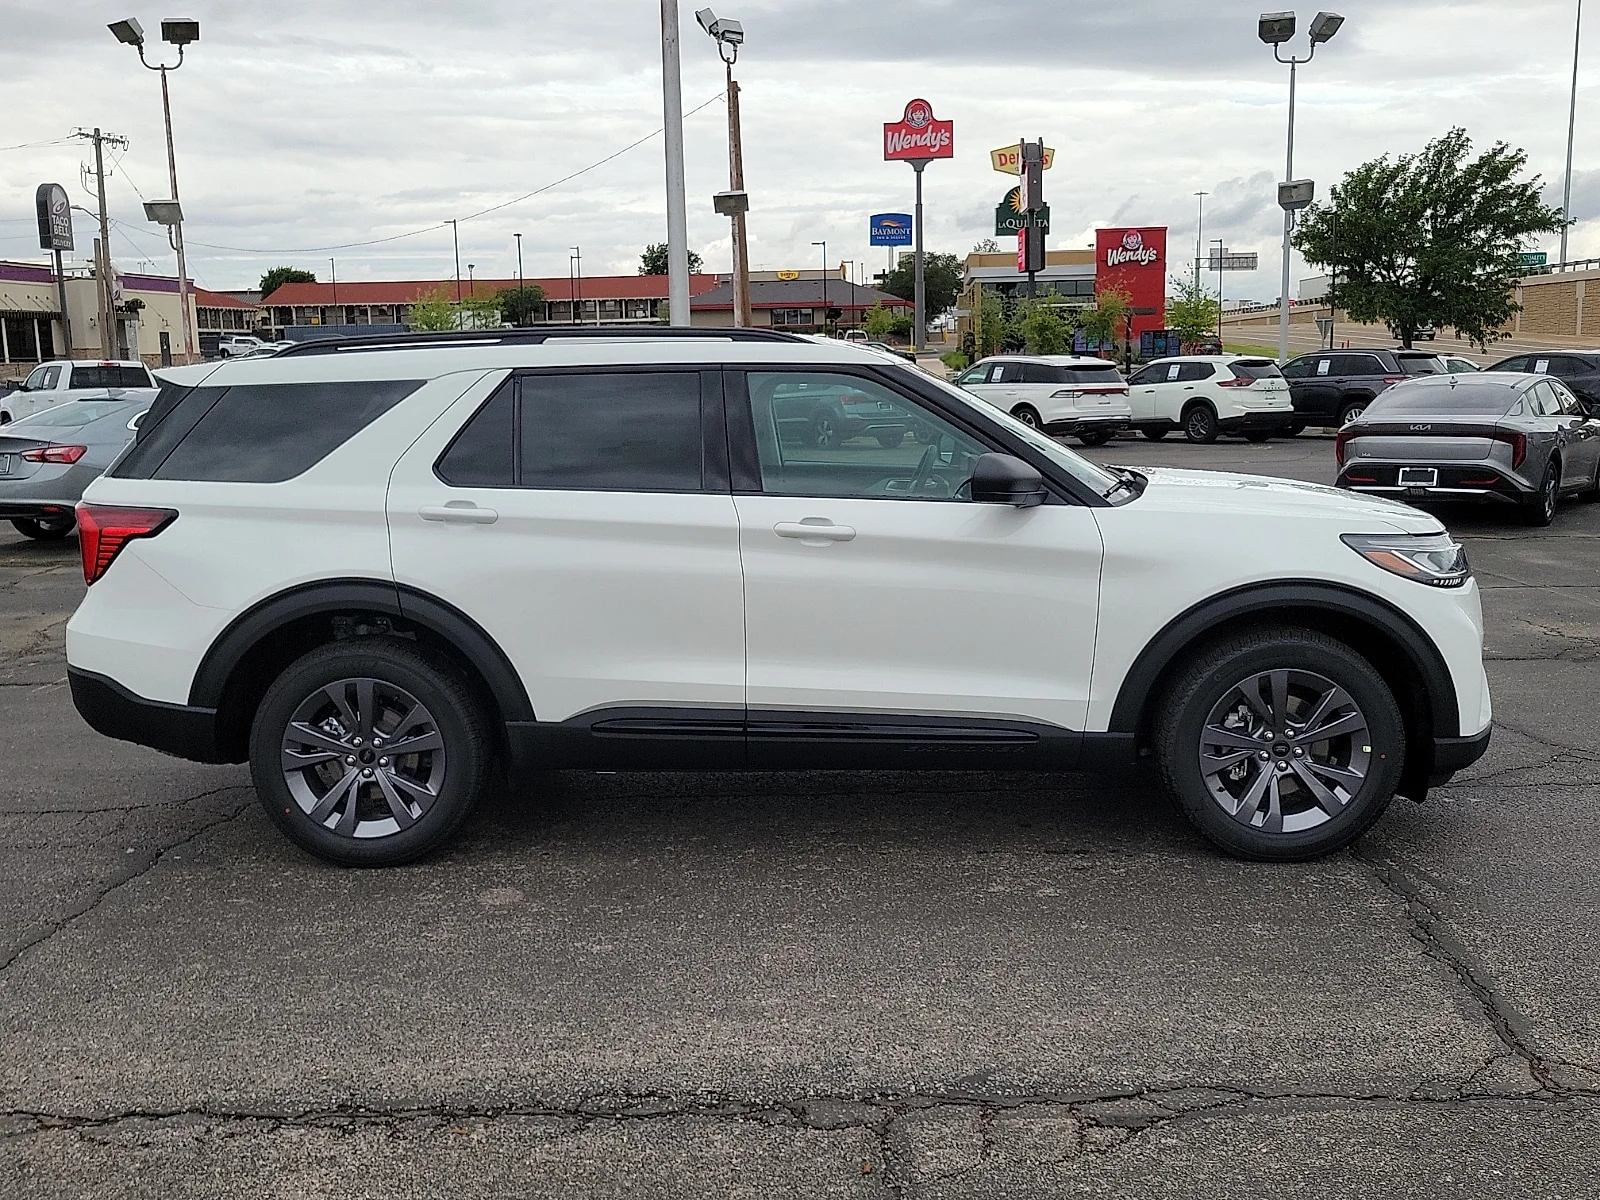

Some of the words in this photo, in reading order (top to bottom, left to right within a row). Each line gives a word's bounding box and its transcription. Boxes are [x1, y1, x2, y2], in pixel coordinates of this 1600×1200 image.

[887, 124, 950, 154] Wendy's
[51, 214, 69, 227] TACO
[1006, 218, 1049, 230] QUITA
[53, 224, 70, 237] BELL
[871, 227, 911, 236] BAYMONT
[1107, 244, 1157, 267] Wendy's
